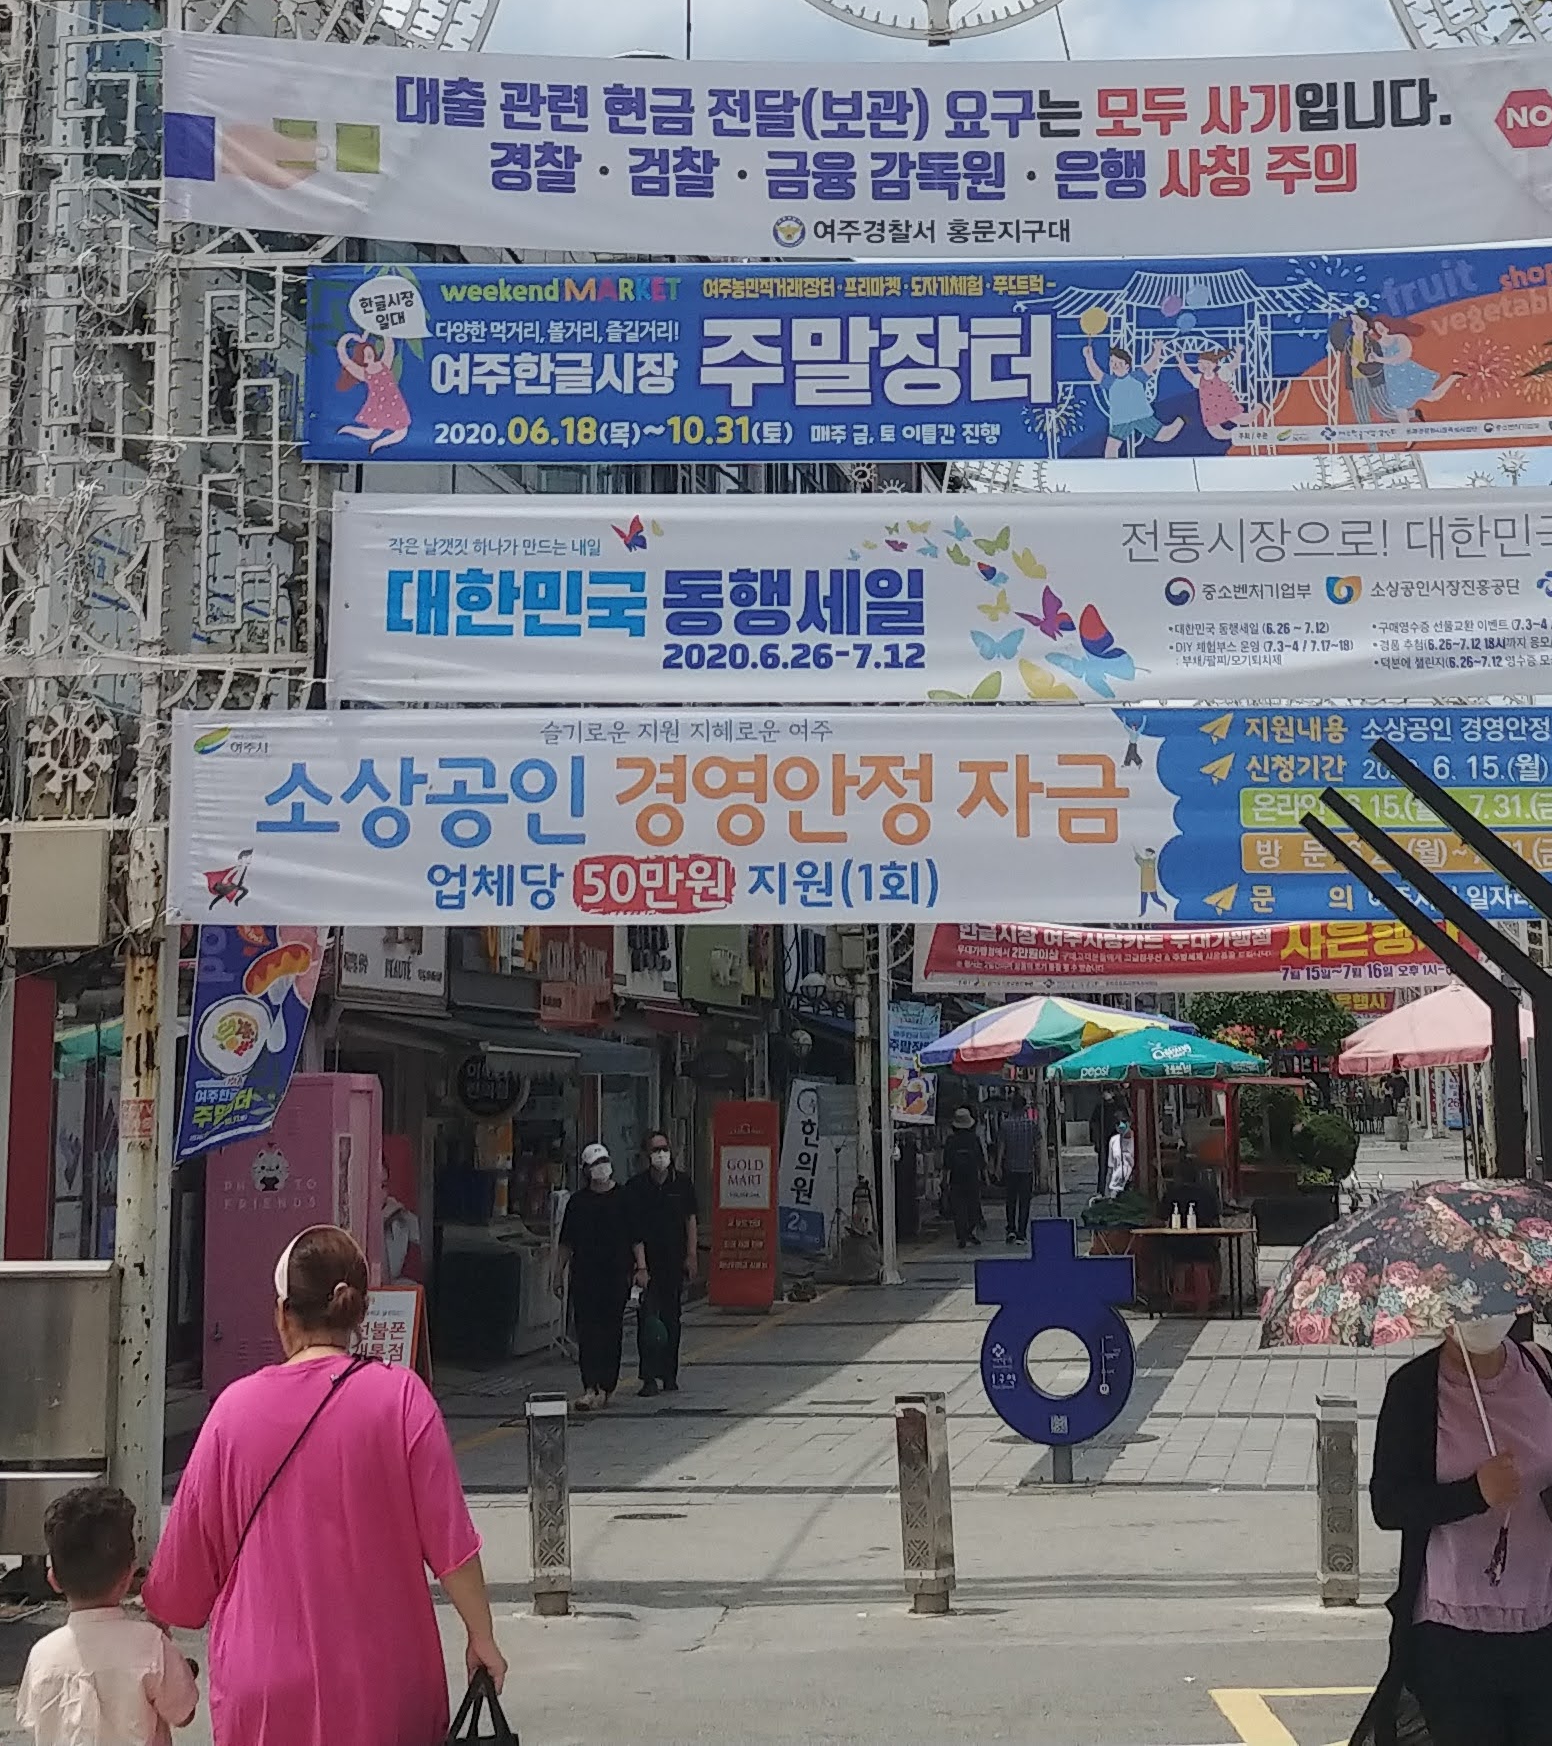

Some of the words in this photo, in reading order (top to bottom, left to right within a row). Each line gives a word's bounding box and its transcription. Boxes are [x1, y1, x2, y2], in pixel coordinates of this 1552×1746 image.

[395, 74, 486, 127] 대출
[499, 82, 589, 134] 관련
[605, 83, 696, 136] 현금
[707, 86, 930, 142] 전달(보관)
[945, 87, 1082, 141] 요구는
[1096, 86, 1187, 139] 모두
[1200, 77, 1453, 136] 사기입니다.
[489, 141, 582, 194] 경찰
[629, 146, 719, 200] 검찰
[765, 150, 858, 201] 금융
[869, 150, 1005, 201] 감독원
[1054, 147, 1147, 200] 은행
[1158, 146, 1250, 198] 사칭
[1266, 143, 1358, 195] 주의
[812, 217, 937, 246] 여주경찰서
[947, 217, 1071, 246] 홍문지구대
[440, 278, 559, 303] weekend
[565, 277, 681, 302] MARKET
[844, 276, 902, 299] 프리마켓
[910, 275, 984, 298] 도자기체험
[1383, 258, 1478, 318] fruit
[358, 289, 415, 314] 한글시장
[375, 312, 406, 331] 일대
[435, 321, 488, 344] 다양한
[490, 320, 546, 344] 먹거리,
[547, 320, 603, 344] 볼거리,
[606, 320, 680, 342] 즐길거리!
[430, 352, 679, 395] 여주한글시장
[700, 315, 1053, 408] 주말장터
[810, 423, 847, 445] 매주
[901, 424, 955, 445] 이틀간
[962, 424, 1001, 445] 진행
[388, 538, 420, 556] 작은
[423, 538, 468, 556] 날갯짓
[473, 538, 518, 555] 하나가
[522, 538, 568, 556] 만드는
[571, 538, 601, 556] 내일
[1122, 518, 1388, 564] 전통시장으로!
[1201, 583, 1312, 601] 중소벤처기업부
[1370, 577, 1521, 598] 소상공인시장진흥공단
[386, 567, 647, 637] 대한민국
[662, 567, 925, 637] 동행세일
[1477, 618, 1509, 632] 이벤트
[662, 642, 925, 670] 2020.6.26-7.12
[1175, 642, 1194, 652] DIY
[540, 720, 630, 746] 슬기로운
[637, 720, 681, 745] 지원
[689, 719, 781, 745] 지혜로운
[788, 719, 834, 745] 여주
[1244, 715, 1347, 744] 지원내용
[1360, 716, 1453, 742] 소상공인
[1460, 717, 1551, 742] 경영안정
[229, 740, 269, 754] 여주시
[1245, 755, 1346, 783] 신청기간
[1467, 754, 1549, 783] 15.(월)
[255, 754, 587, 849] 소상공인
[615, 753, 934, 848] 경영안정
[956, 753, 1131, 844] 자금
[426, 862, 565, 910] 업체당
[580, 858, 728, 911] 50만원
[746, 858, 940, 909] 지원(1회)
[1367, 963, 1393, 979] 16일
[1398, 966, 1417, 977] 오후
[727, 1159, 763, 1172] GOLD
[790, 1119, 819, 1206] 한의원
[728, 1174, 762, 1187] MART
